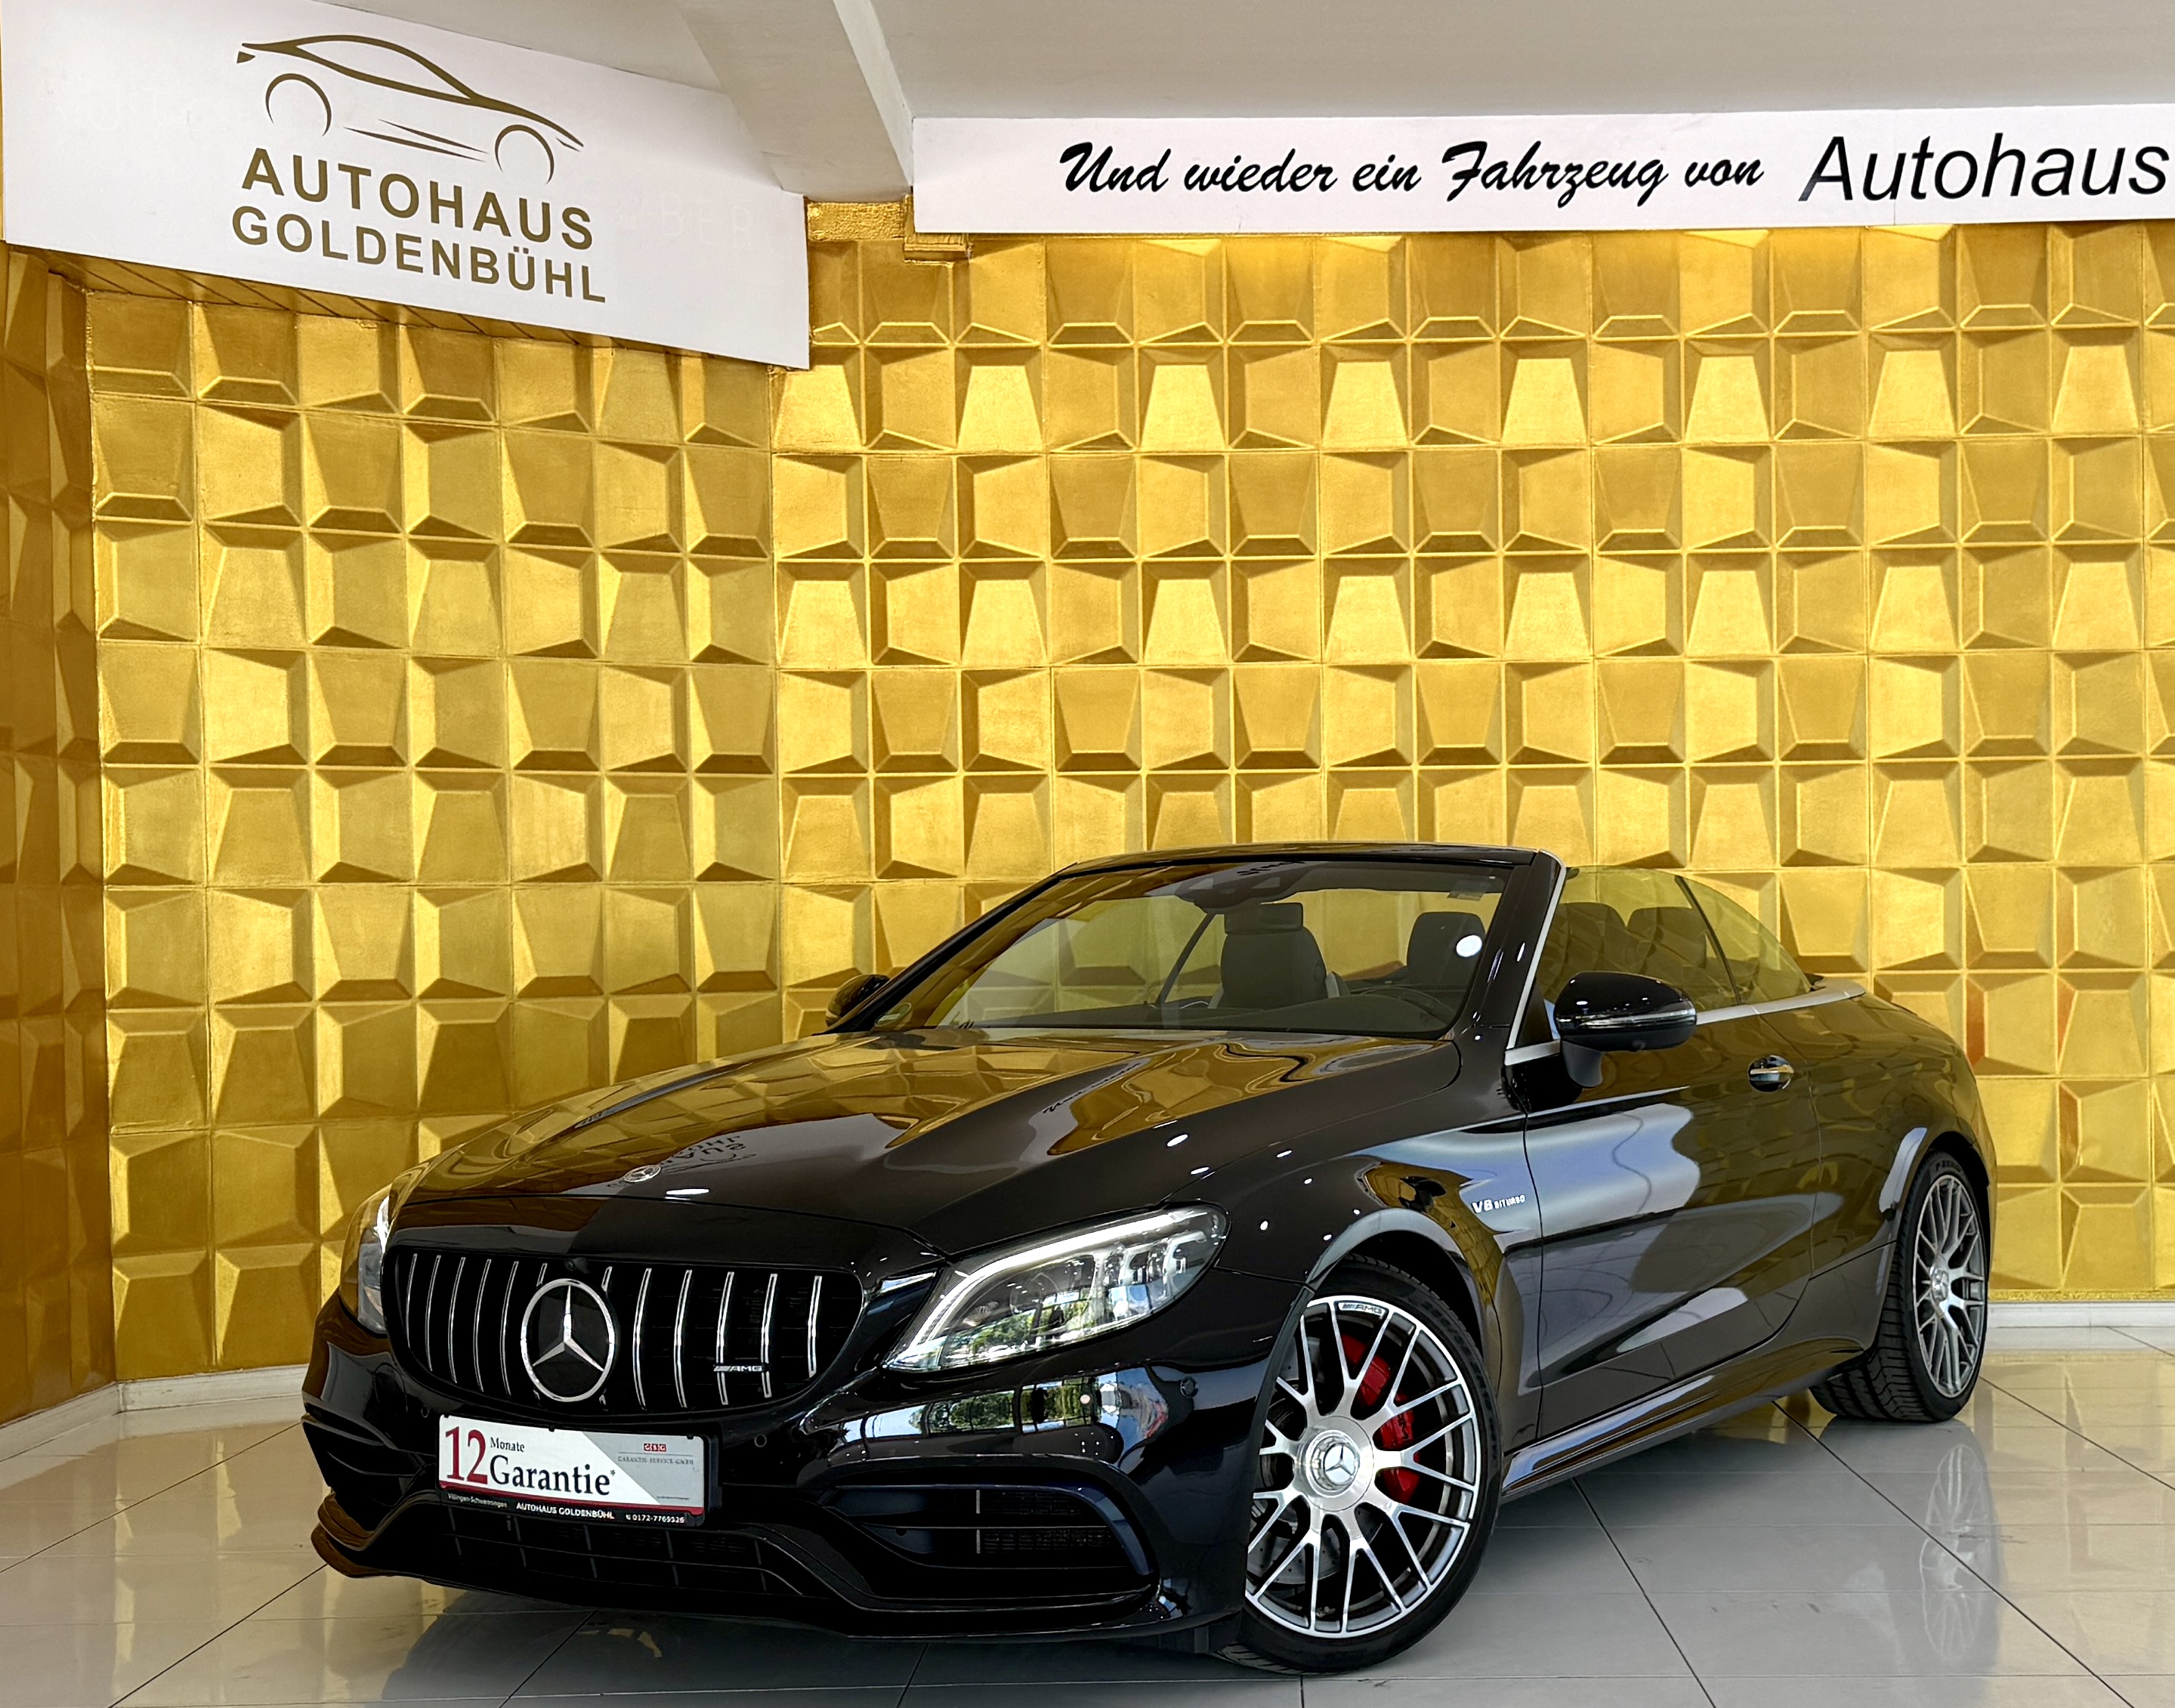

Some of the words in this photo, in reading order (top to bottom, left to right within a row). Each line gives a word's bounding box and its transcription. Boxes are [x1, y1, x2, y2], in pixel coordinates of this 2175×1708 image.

[241, 147, 592, 250] AUTOHAUS
[1059, 141, 1172, 193] Und
[1184, 148, 1338, 193] wieder
[1352, 154, 1423, 192] ein
[1441, 141, 1669, 208] Fahrzeug
[1684, 159, 1765, 187] von
[1798, 132, 2170, 202] Autohaus
[232, 205, 606, 303] GOLDENBÜHL
[445, 1425, 488, 1485] 12
[490, 1437, 525, 1452] Monate
[516, 1502, 558, 1515] AUTOHAUS
